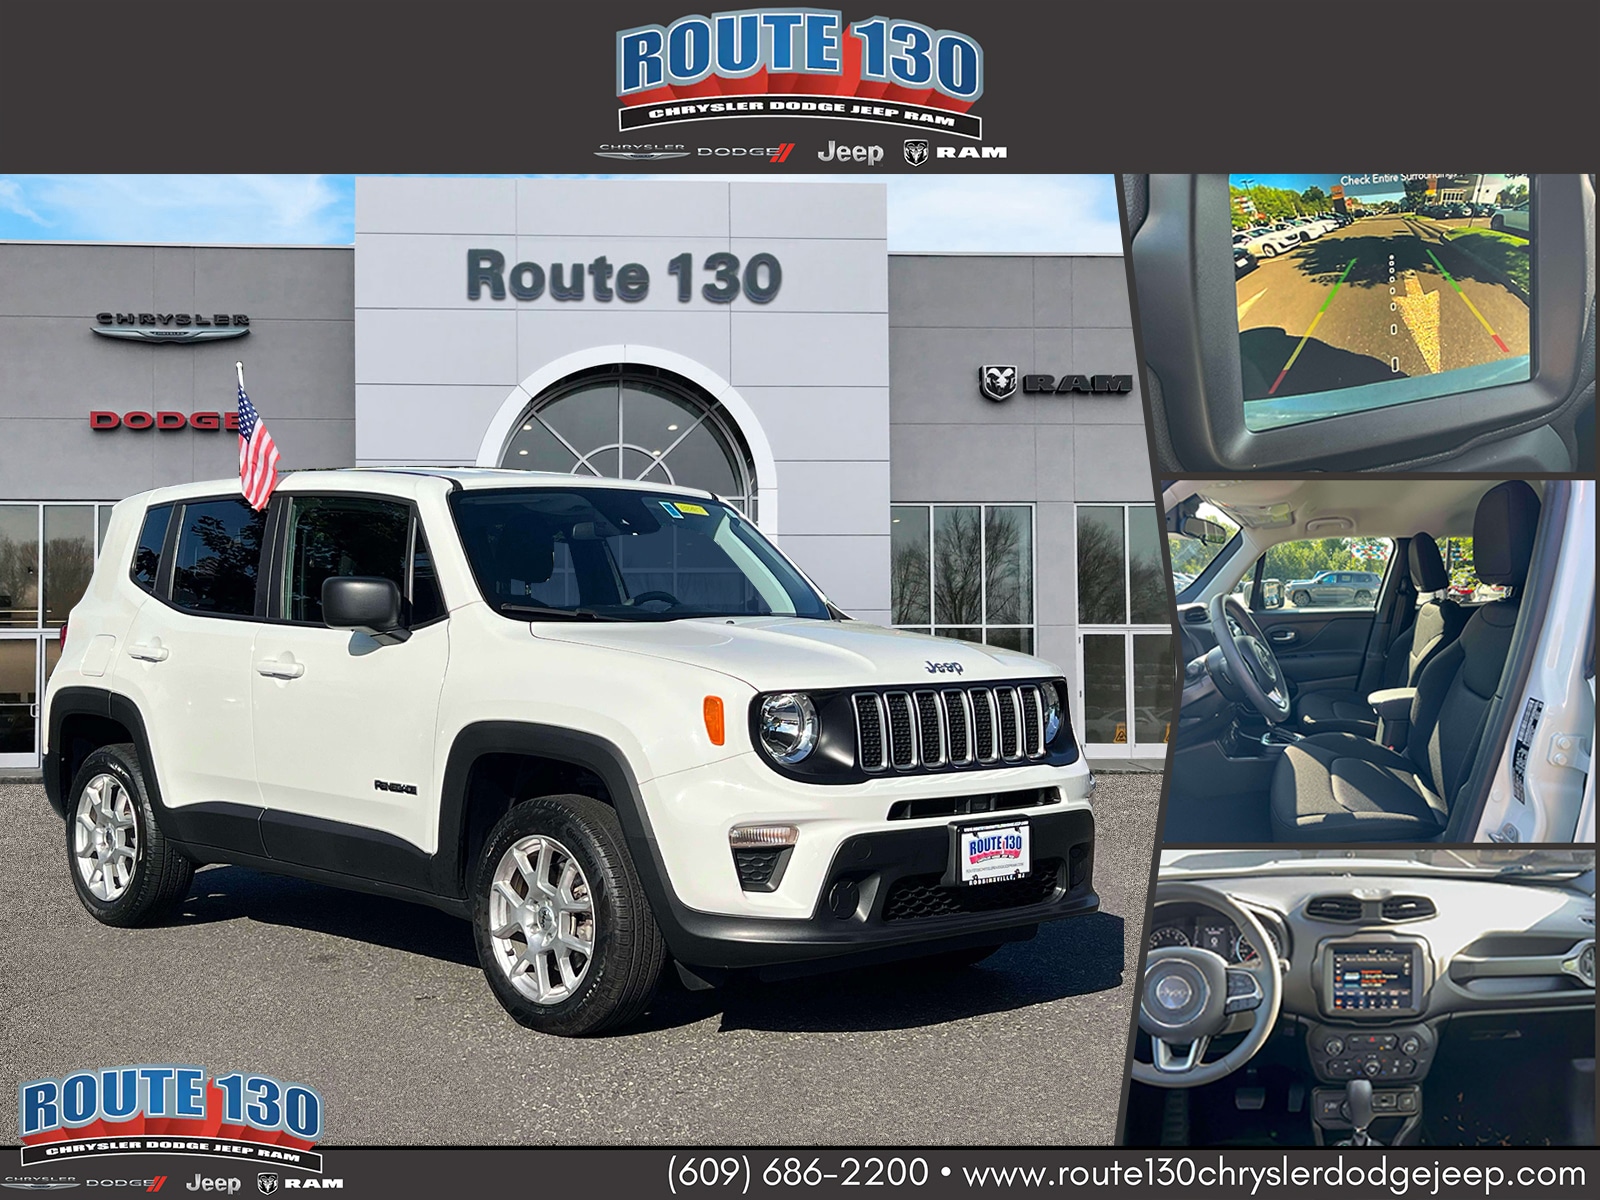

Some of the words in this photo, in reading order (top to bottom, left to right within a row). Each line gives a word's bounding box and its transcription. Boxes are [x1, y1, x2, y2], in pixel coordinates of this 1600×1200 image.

[1340, 174, 1371, 187] Check
[1372, 173, 1399, 184] Entire
[466, 248, 650, 302] Route
[667, 251, 782, 303] 130
[96, 312, 250, 326] CHRYSLER
[1023, 374, 1133, 394] RAM
[924, 660, 964, 676] Jeep
[969, 836, 1002, 856] ROUTE
[1004, 835, 1022, 850] 130
